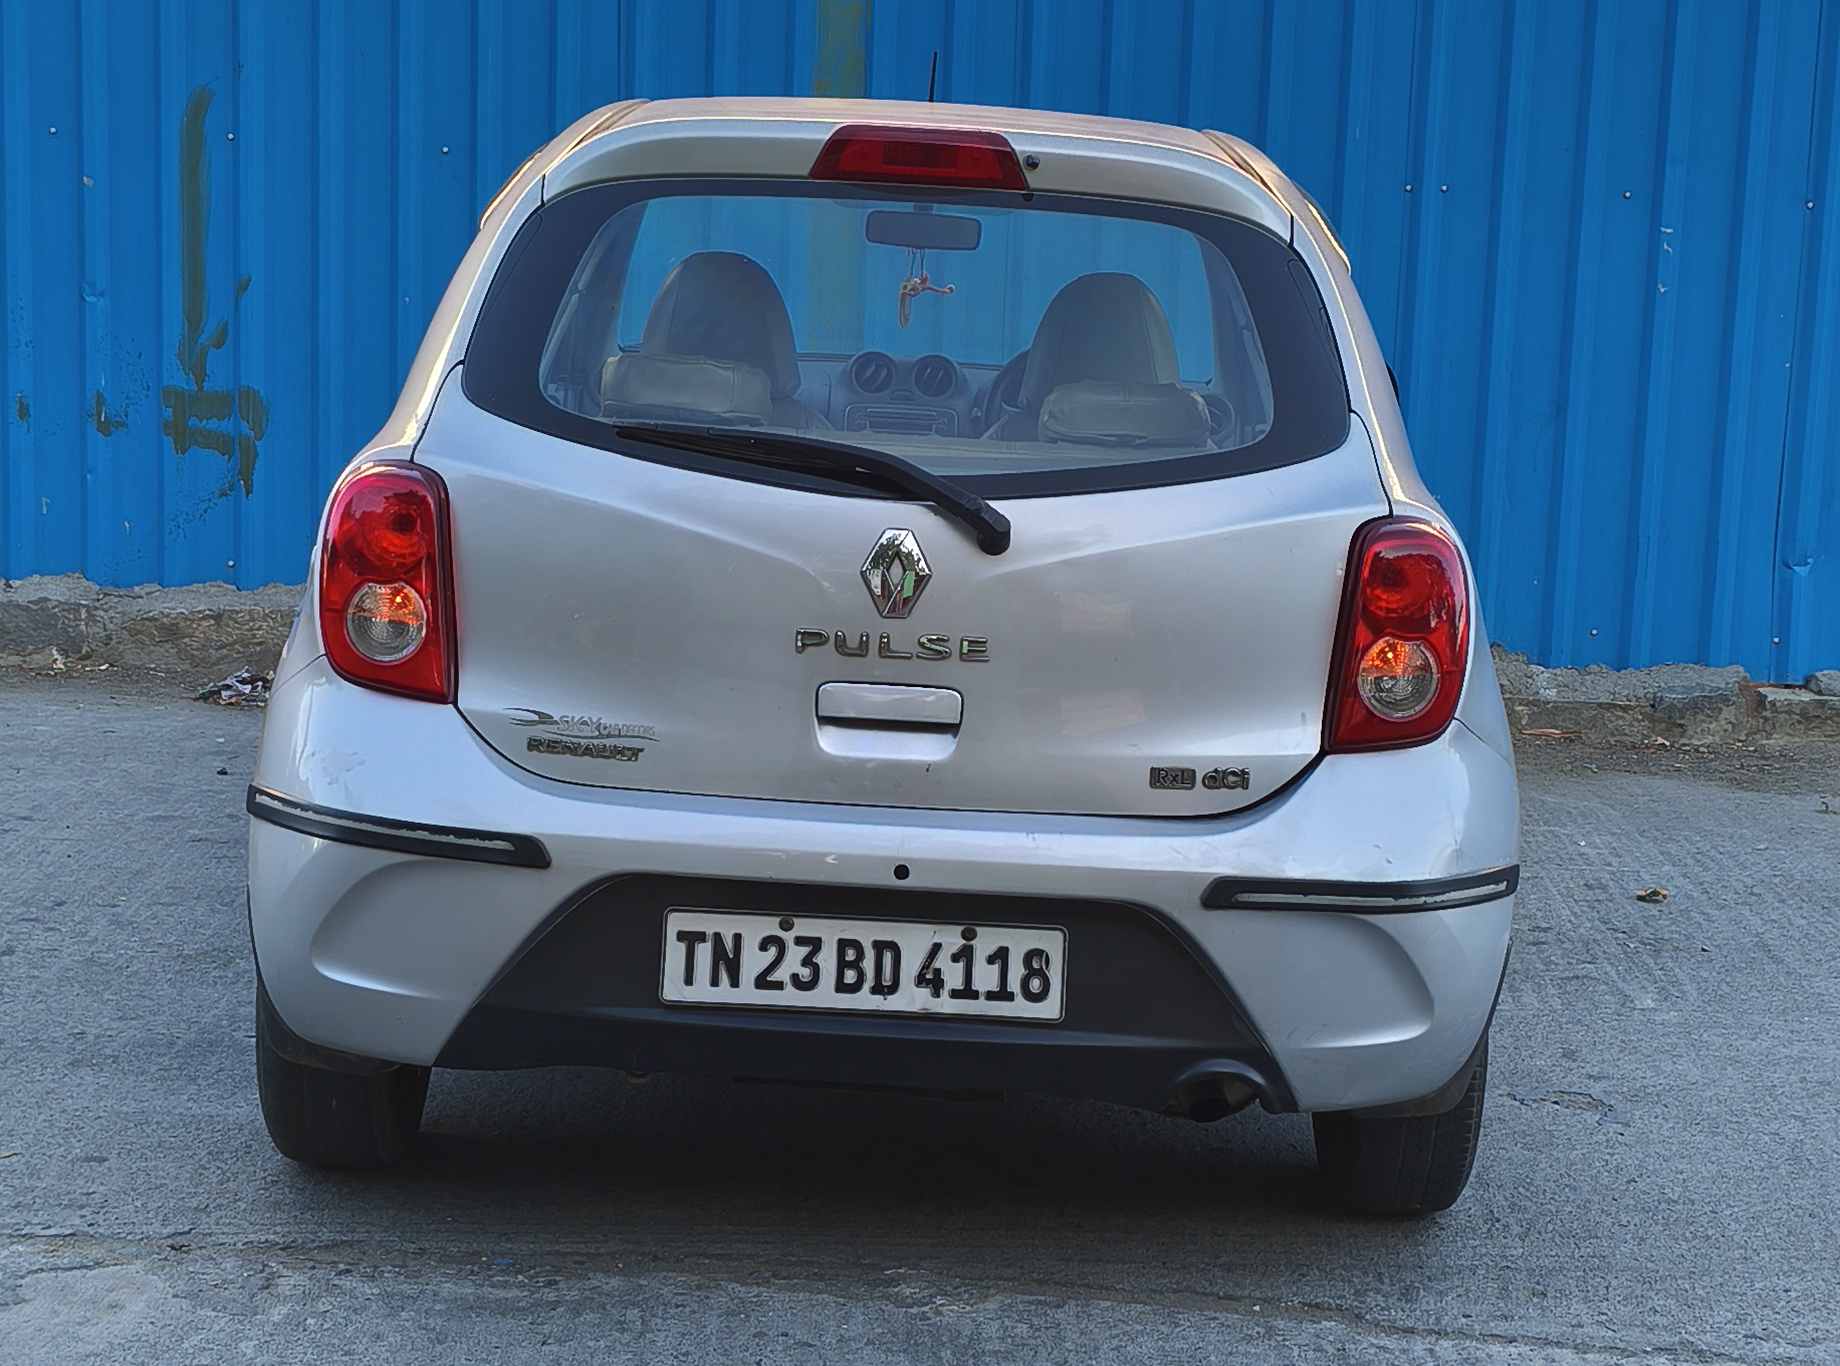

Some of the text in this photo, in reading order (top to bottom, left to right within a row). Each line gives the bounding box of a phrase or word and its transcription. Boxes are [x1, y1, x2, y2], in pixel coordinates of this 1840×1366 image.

[794, 627, 990, 662] PULSE
[527, 736, 646, 762] RENAULT
[914, 941, 1053, 1004] 4118
